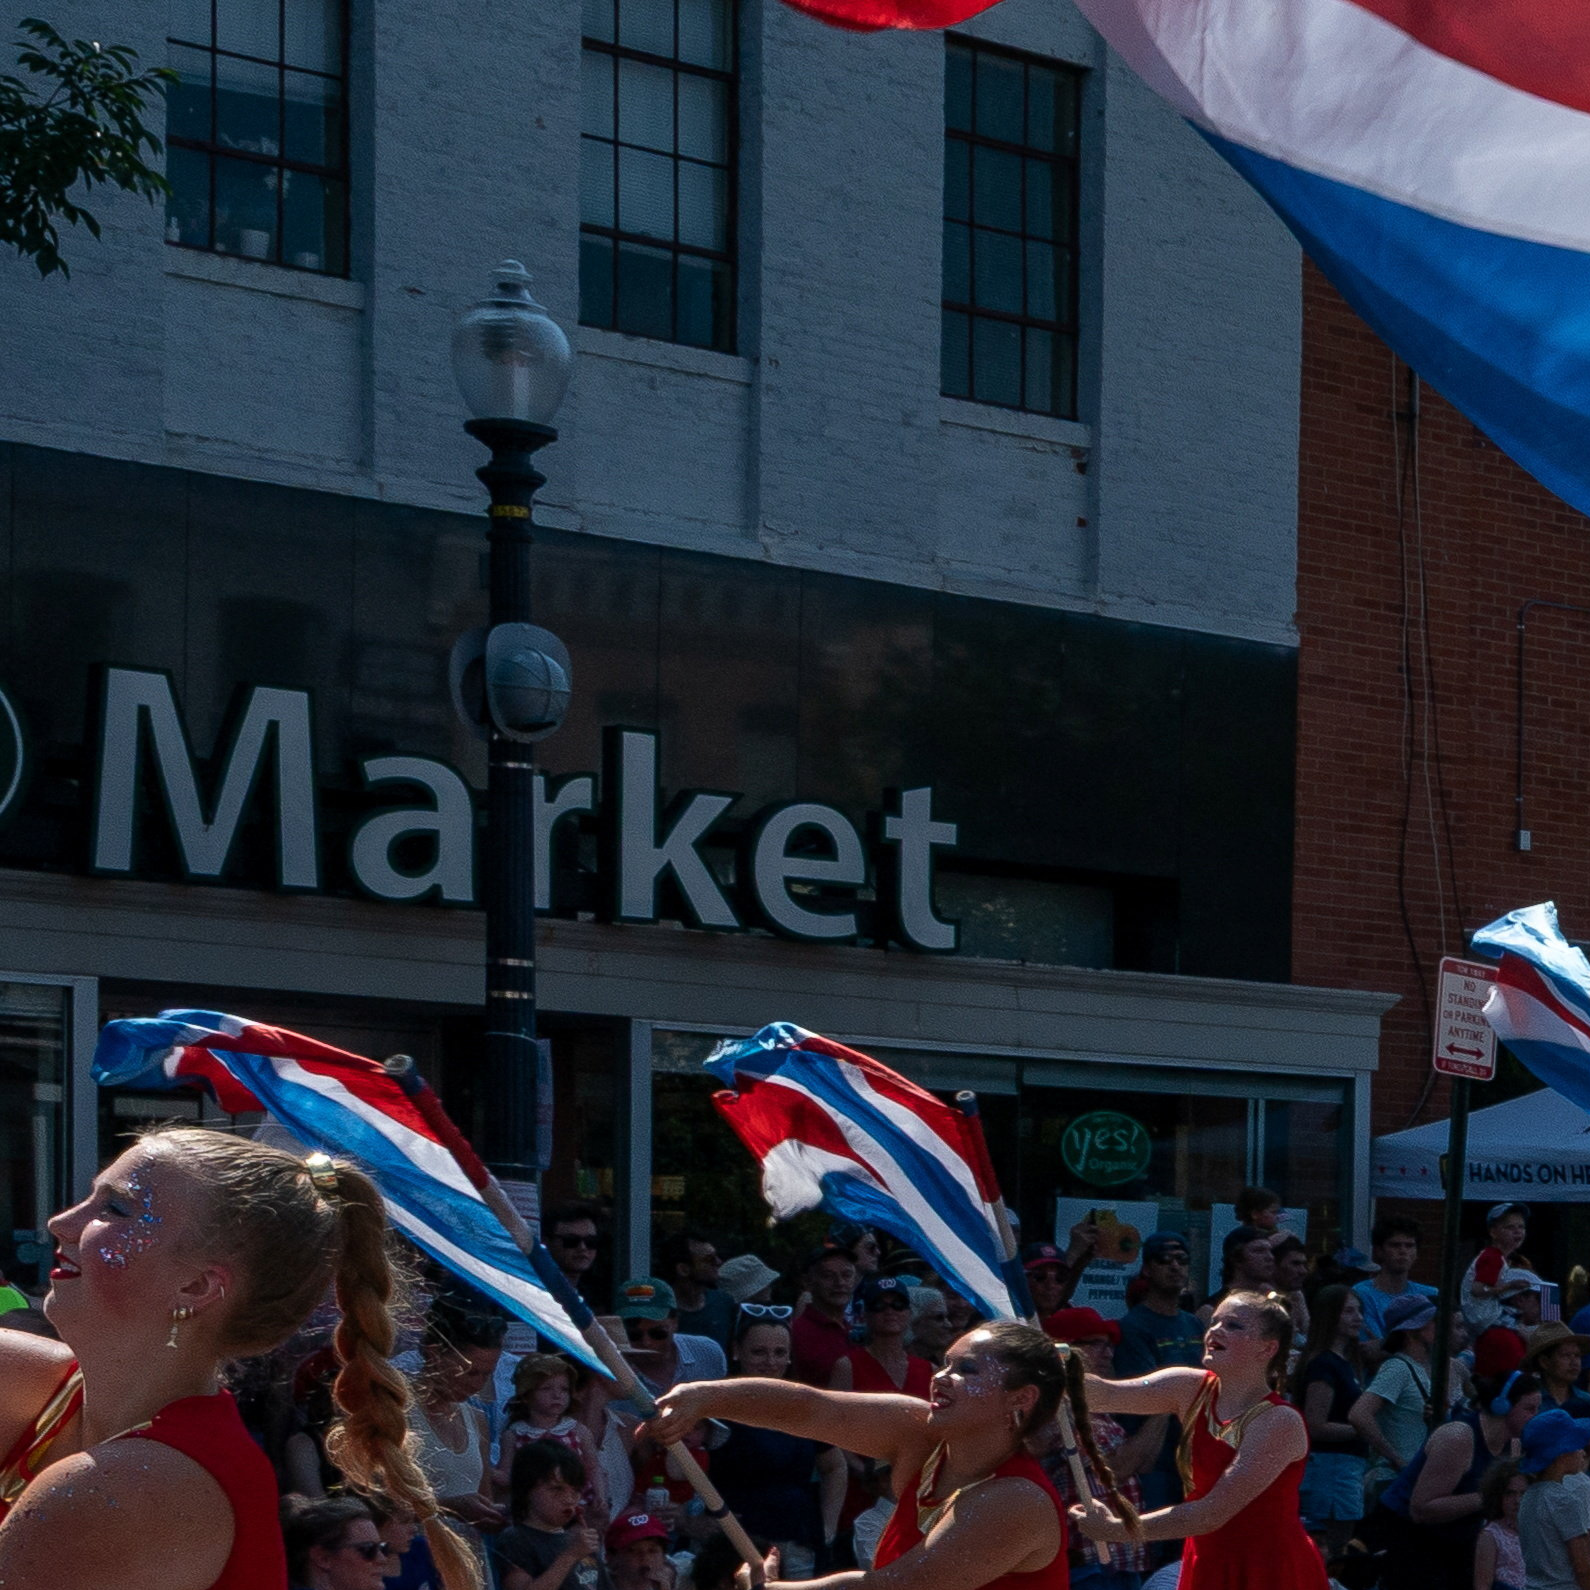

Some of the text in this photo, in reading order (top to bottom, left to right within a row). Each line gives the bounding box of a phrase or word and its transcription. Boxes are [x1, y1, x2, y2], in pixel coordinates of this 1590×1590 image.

[94, 668, 957, 950] Market
[1463, 980, 1476, 992] NO
[1447, 993, 1489, 1010] STANDIN
[1454, 1010, 1491, 1028] PARKIN
[1448, 1026, 1485, 1043] ANYTIME
[1071, 1125, 1139, 1171] yes!
[1469, 1163, 1534, 1184] HANDS
[1537, 1164, 1566, 1185] ON
